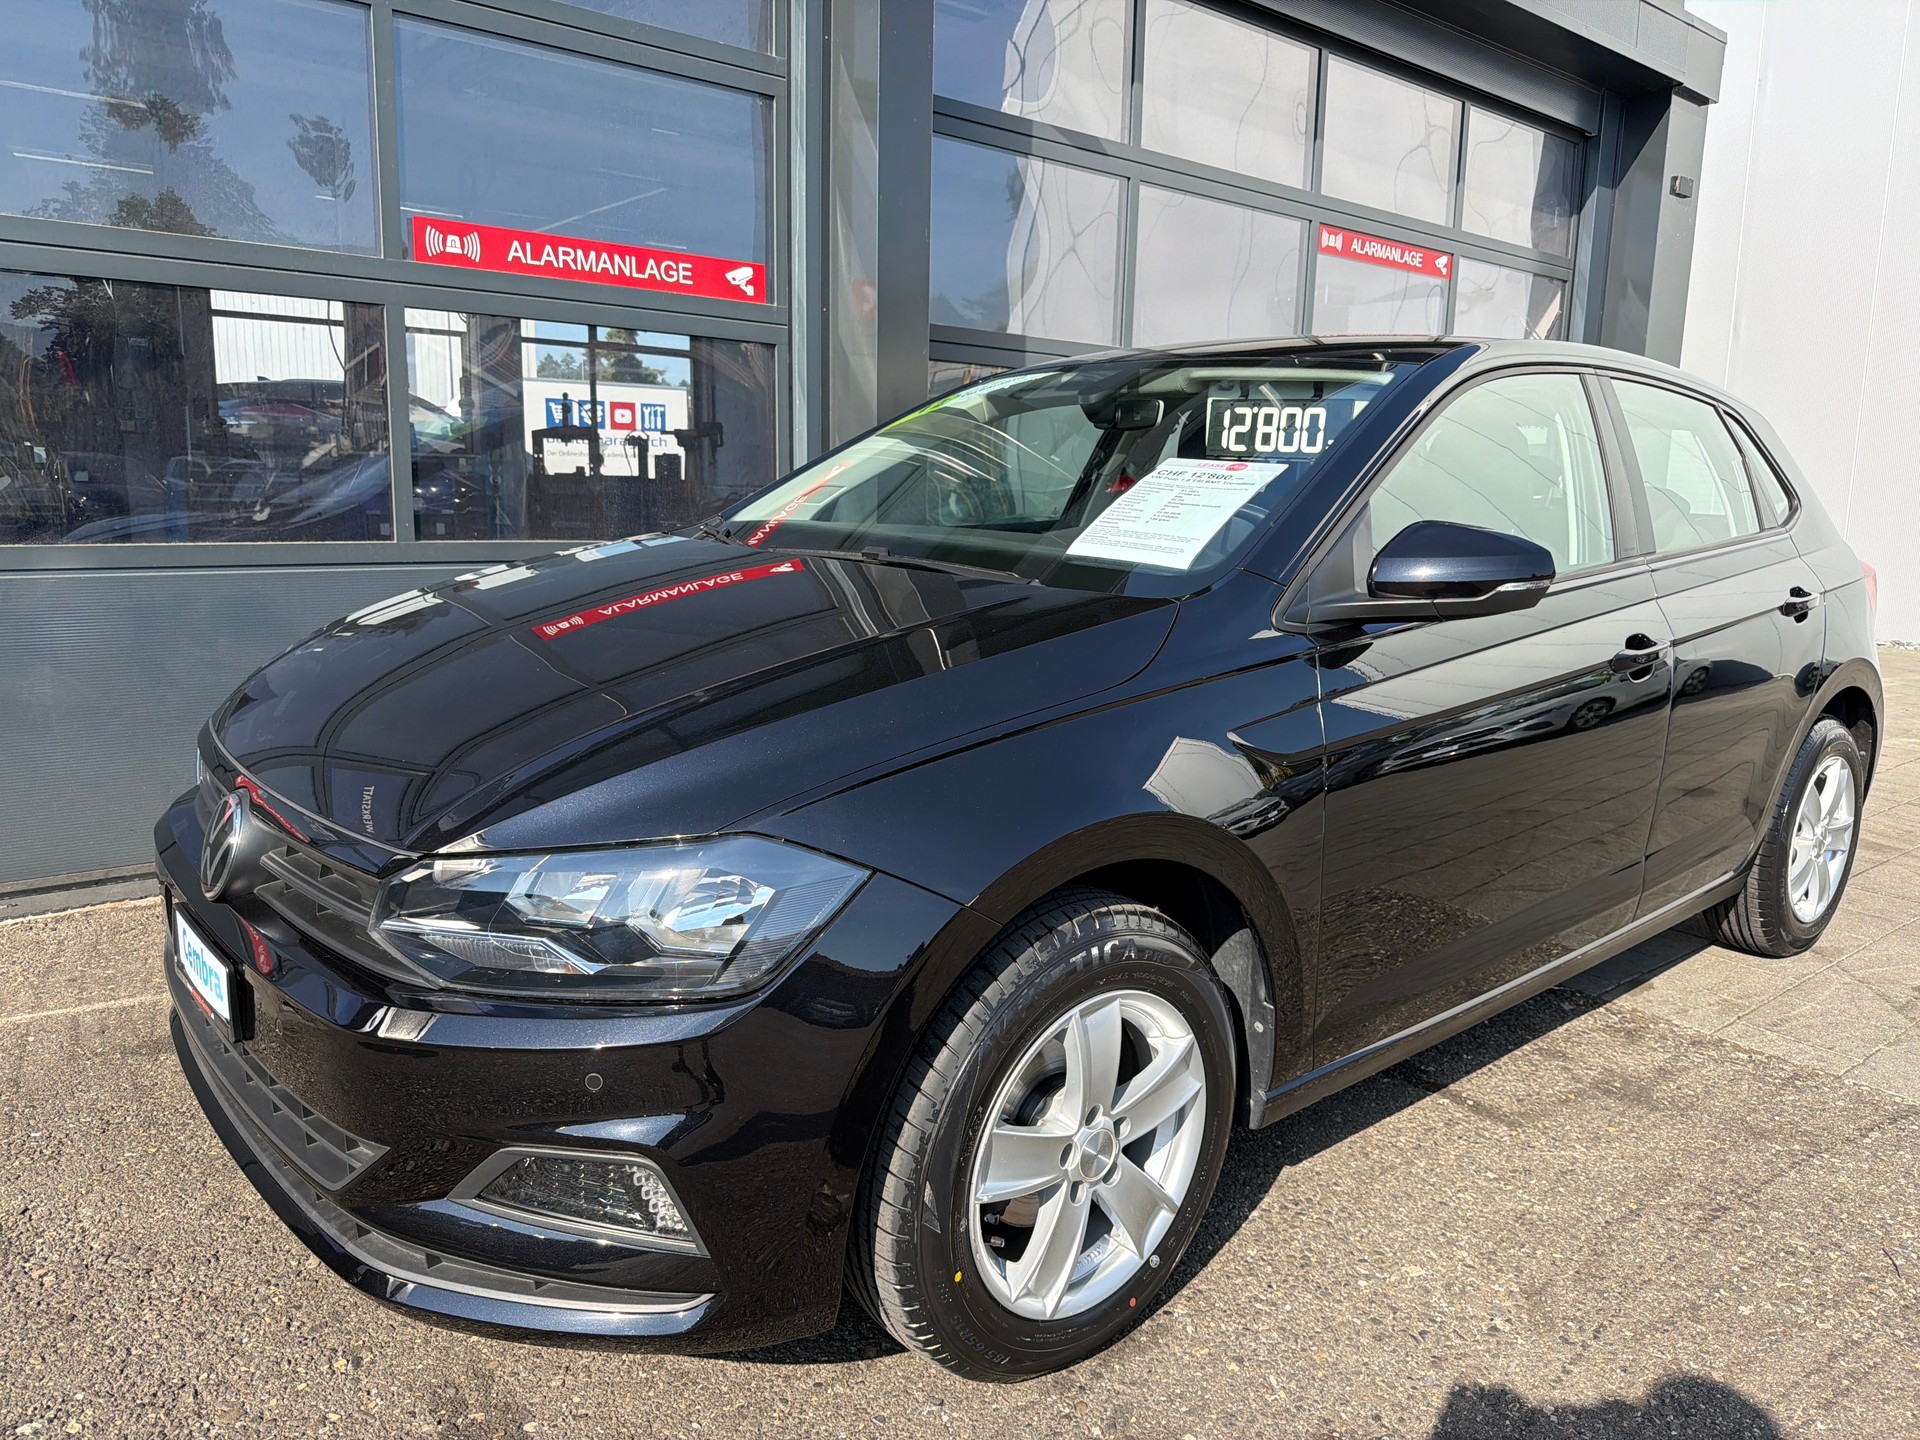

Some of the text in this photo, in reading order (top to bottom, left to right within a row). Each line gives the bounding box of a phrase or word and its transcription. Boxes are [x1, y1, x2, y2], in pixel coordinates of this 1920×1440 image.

[507, 240, 694, 285] ALARMANLAGE
[1350, 237, 1423, 268] ALARMANLAGE
[1157, 469, 1189, 478] CHF
[182, 926, 224, 1003] Cembra
